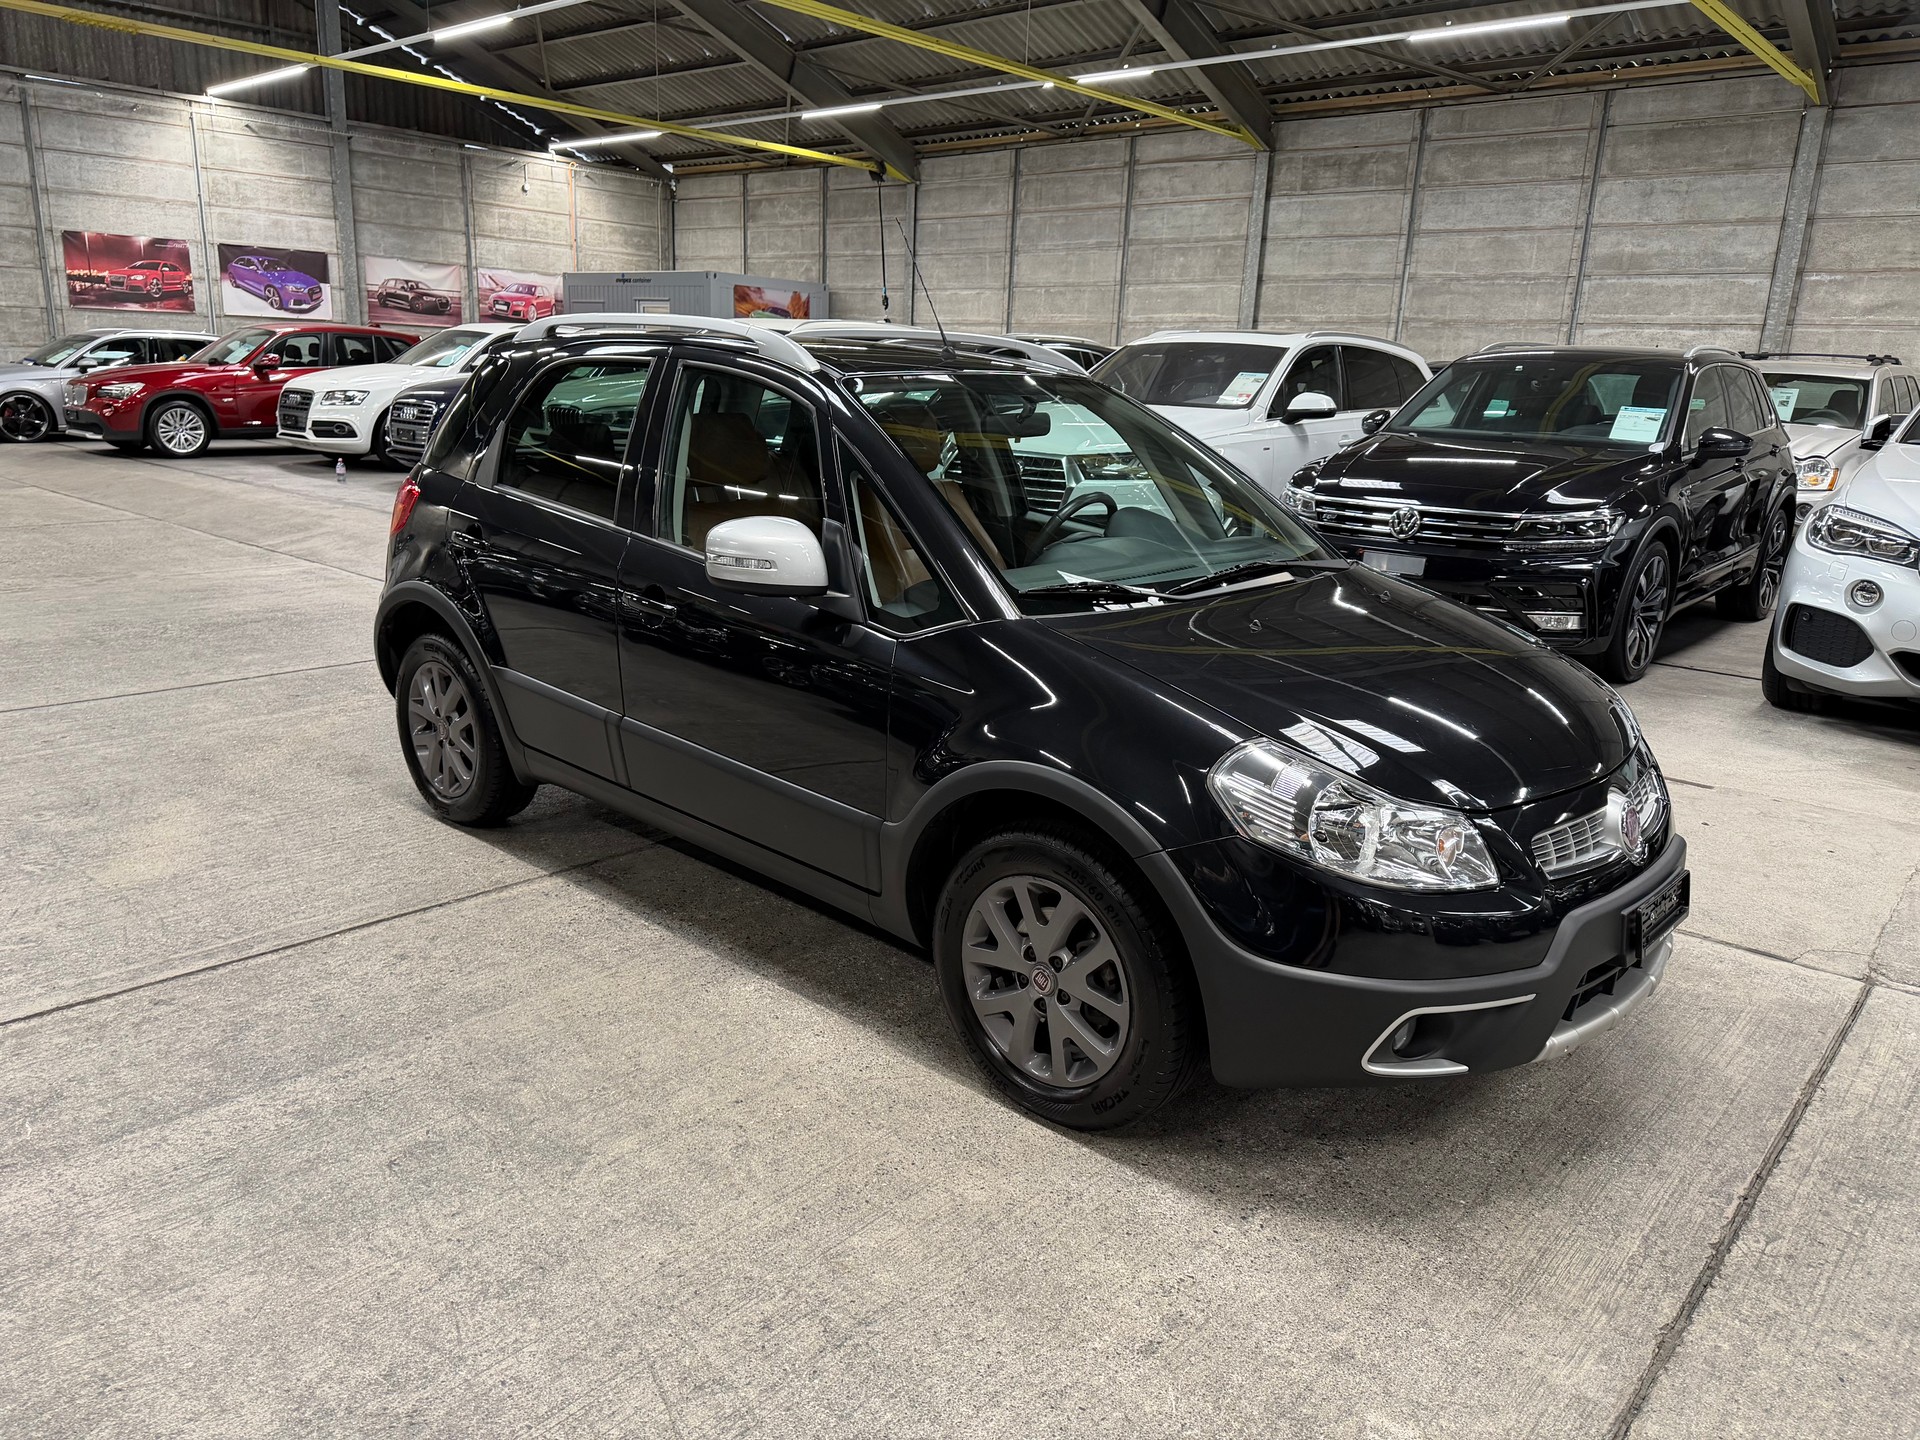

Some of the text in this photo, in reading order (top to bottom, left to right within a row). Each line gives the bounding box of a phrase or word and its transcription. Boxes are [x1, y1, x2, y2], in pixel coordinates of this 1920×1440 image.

[1064, 864, 1123, 927] 205/60 R16
[960, 1031, 1009, 1091] SPIRIT PRO
